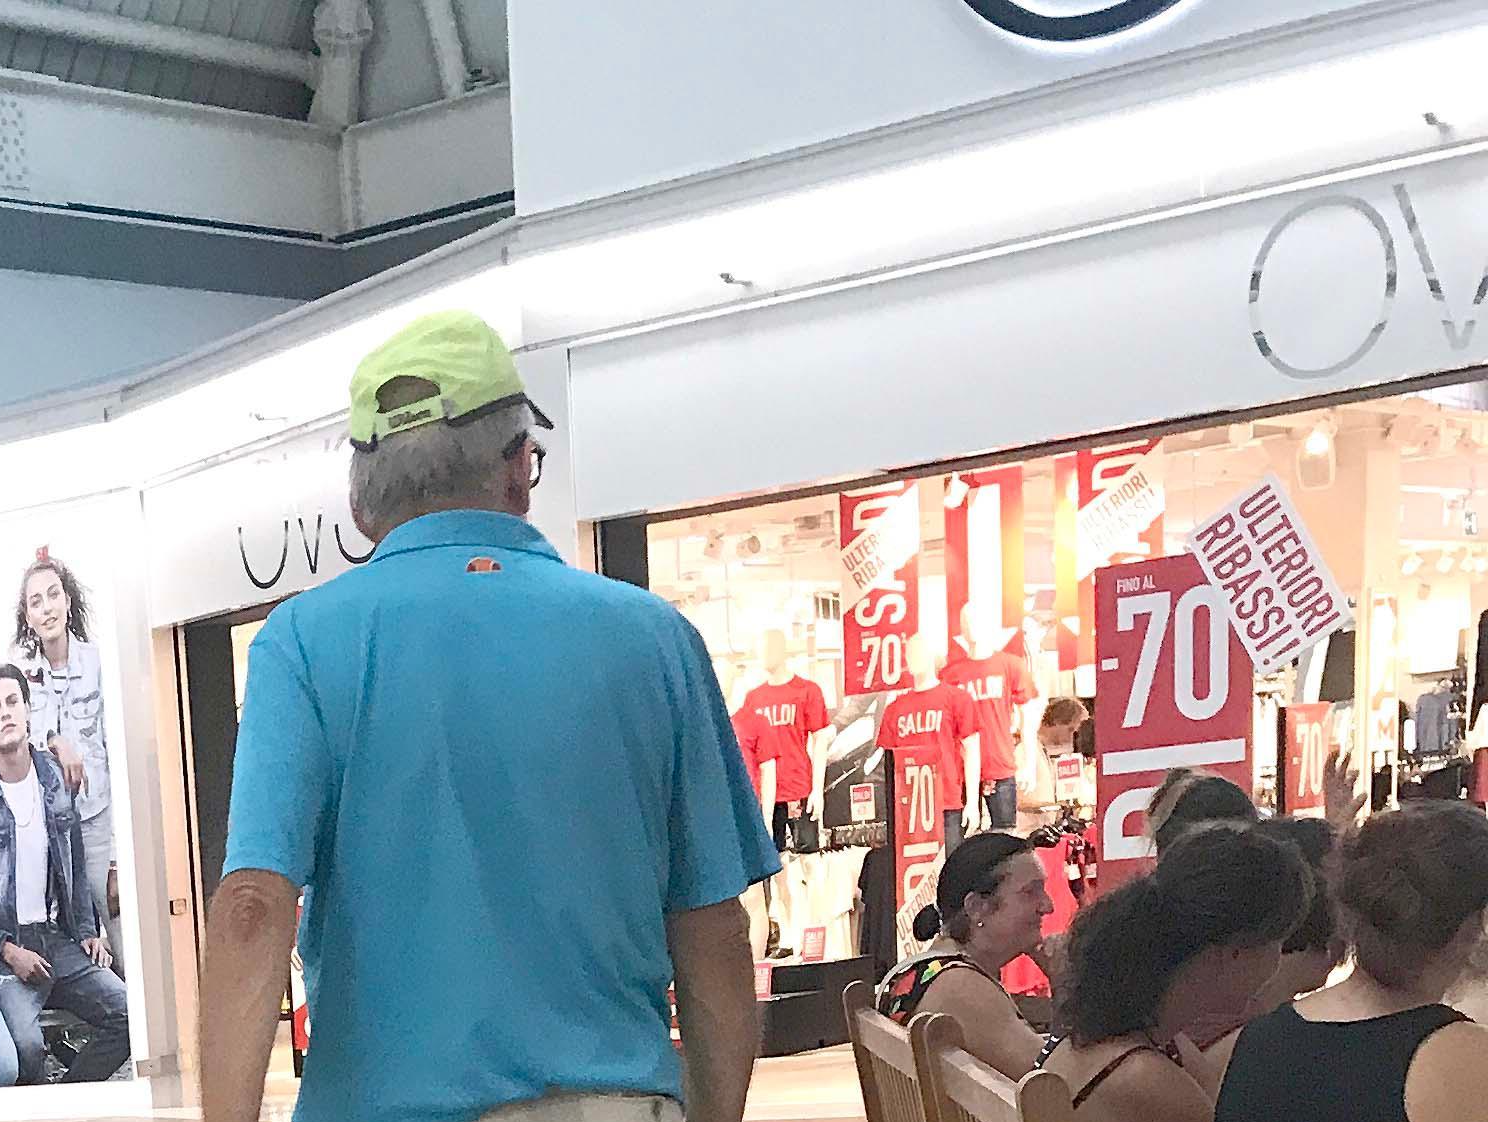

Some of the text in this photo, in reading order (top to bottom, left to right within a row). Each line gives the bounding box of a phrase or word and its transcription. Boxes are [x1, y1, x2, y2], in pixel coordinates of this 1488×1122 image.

[1142, 575, 1156, 590] AL
[1195, 512, 1301, 666] RIBASSI!
[1239, 484, 1341, 637] ULTERIORI
[897, 709, 943, 738] SALDI
